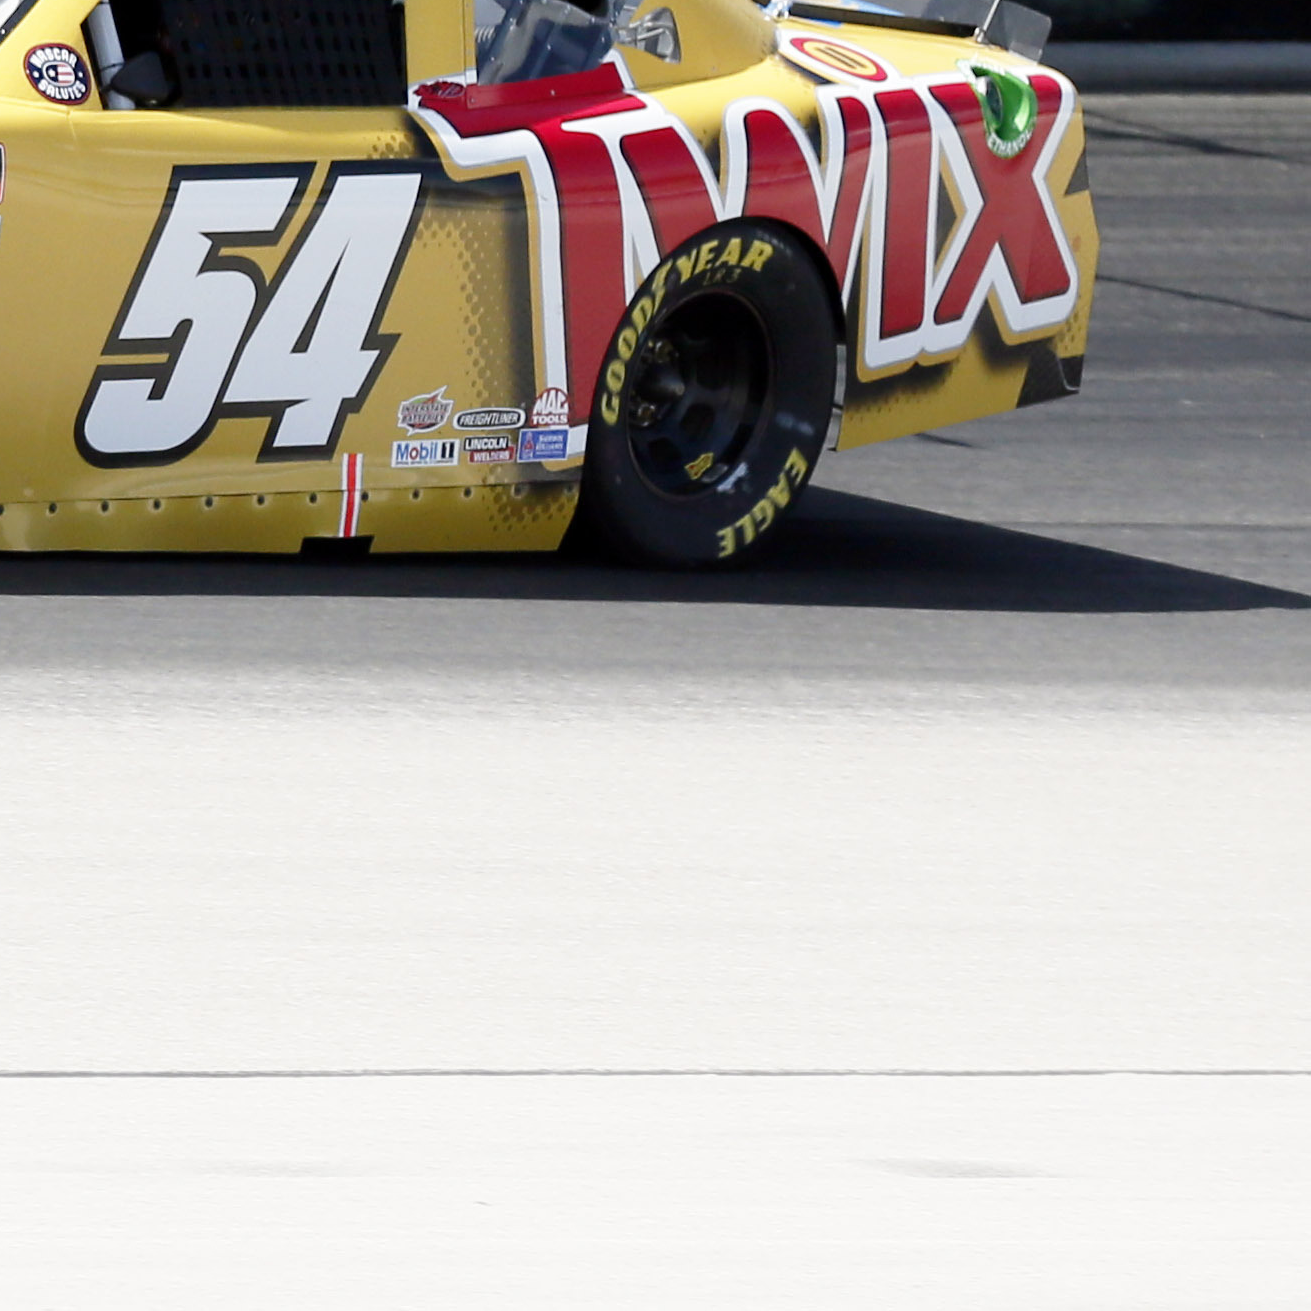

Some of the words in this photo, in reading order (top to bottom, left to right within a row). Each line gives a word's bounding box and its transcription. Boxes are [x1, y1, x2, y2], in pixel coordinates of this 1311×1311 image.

[29, 47, 77, 68] NASCAR
[38, 79, 86, 100] SALUTES
[415, 57, 1079, 426] TWIX
[75, 162, 424, 467] 54
[533, 389, 569, 415] MAC
[459, 411, 519, 426] FREIGHTLINER
[533, 415, 568, 425] TOOLS
[396, 442, 438, 460] Mobil
[441, 442, 455, 459] 1
[465, 438, 508, 450] LINCOLN
[473, 451, 510, 461] WELDERS
[716, 447, 809, 558] EAGLE
